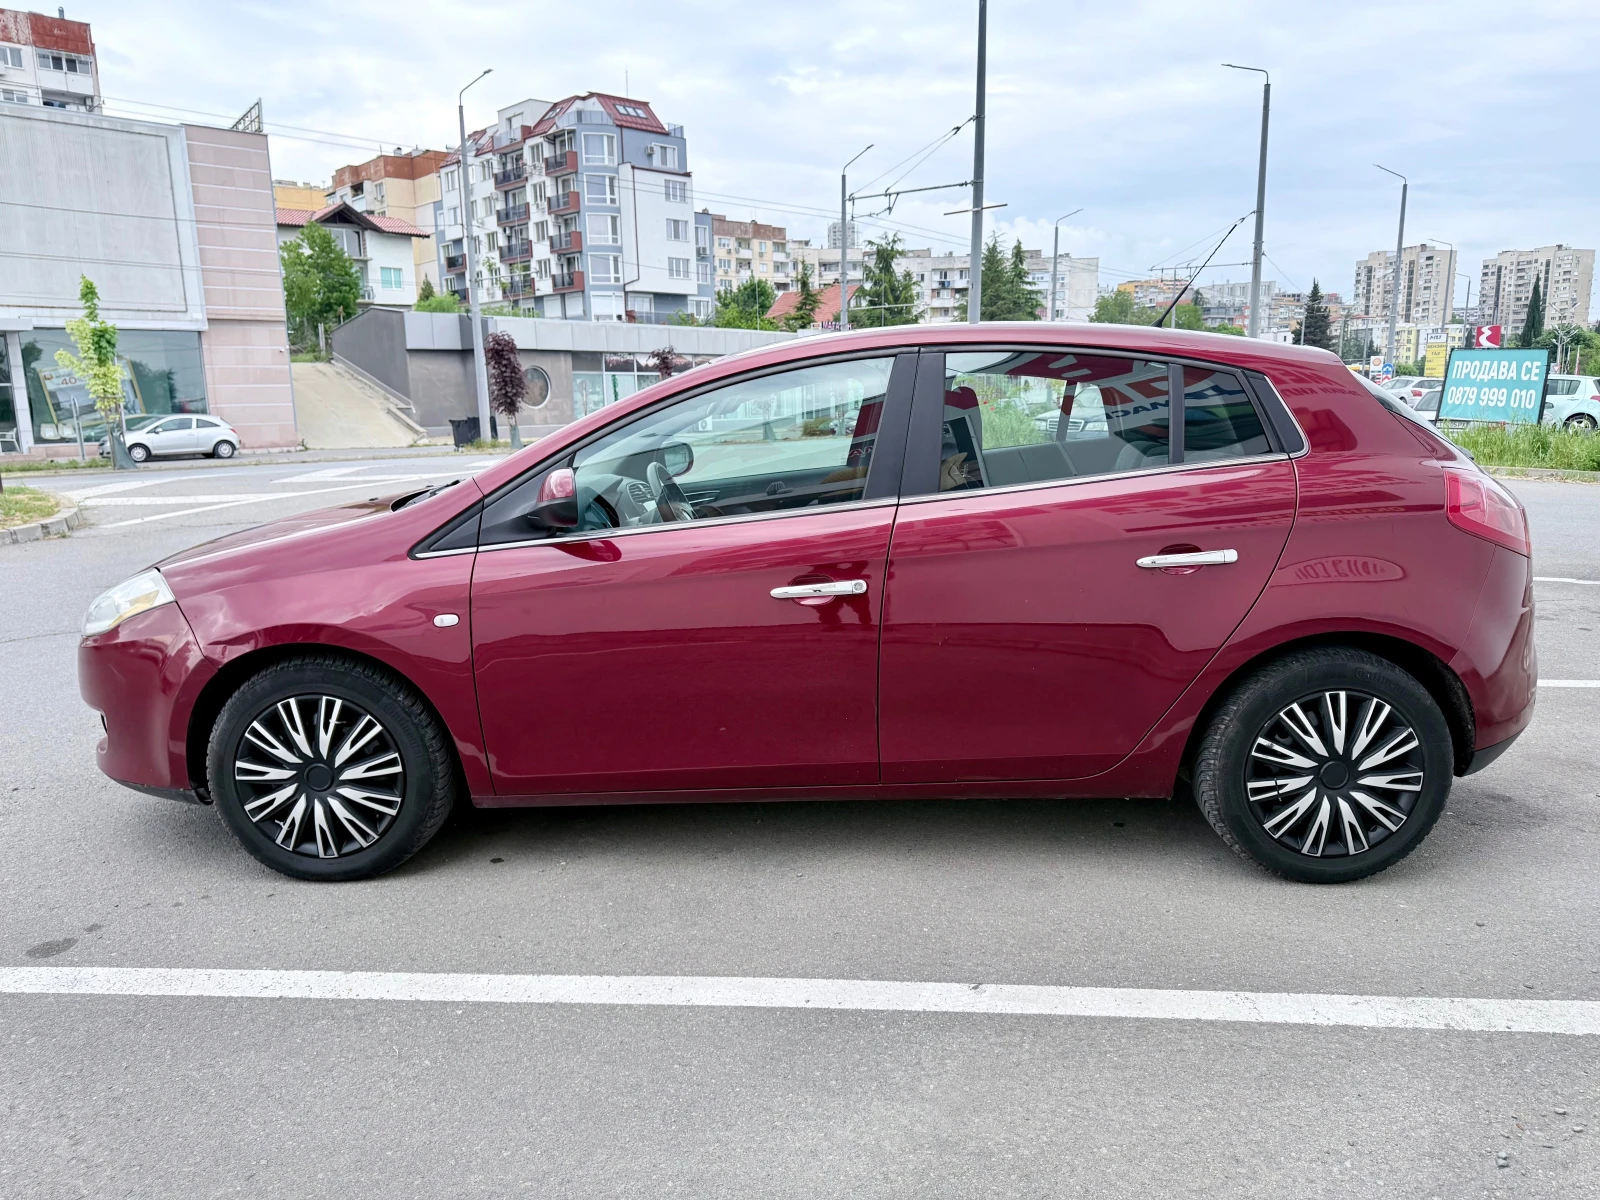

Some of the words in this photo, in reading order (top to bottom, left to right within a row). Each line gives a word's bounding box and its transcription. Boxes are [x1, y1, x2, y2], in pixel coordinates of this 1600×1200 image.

[1452, 360, 1517, 382] ПРОДАВА
[1521, 361, 1541, 381] СЕ
[1447, 386, 1478, 405] 0879
[1479, 387, 1508, 407] 999
[1510, 388, 1536, 409] 010
